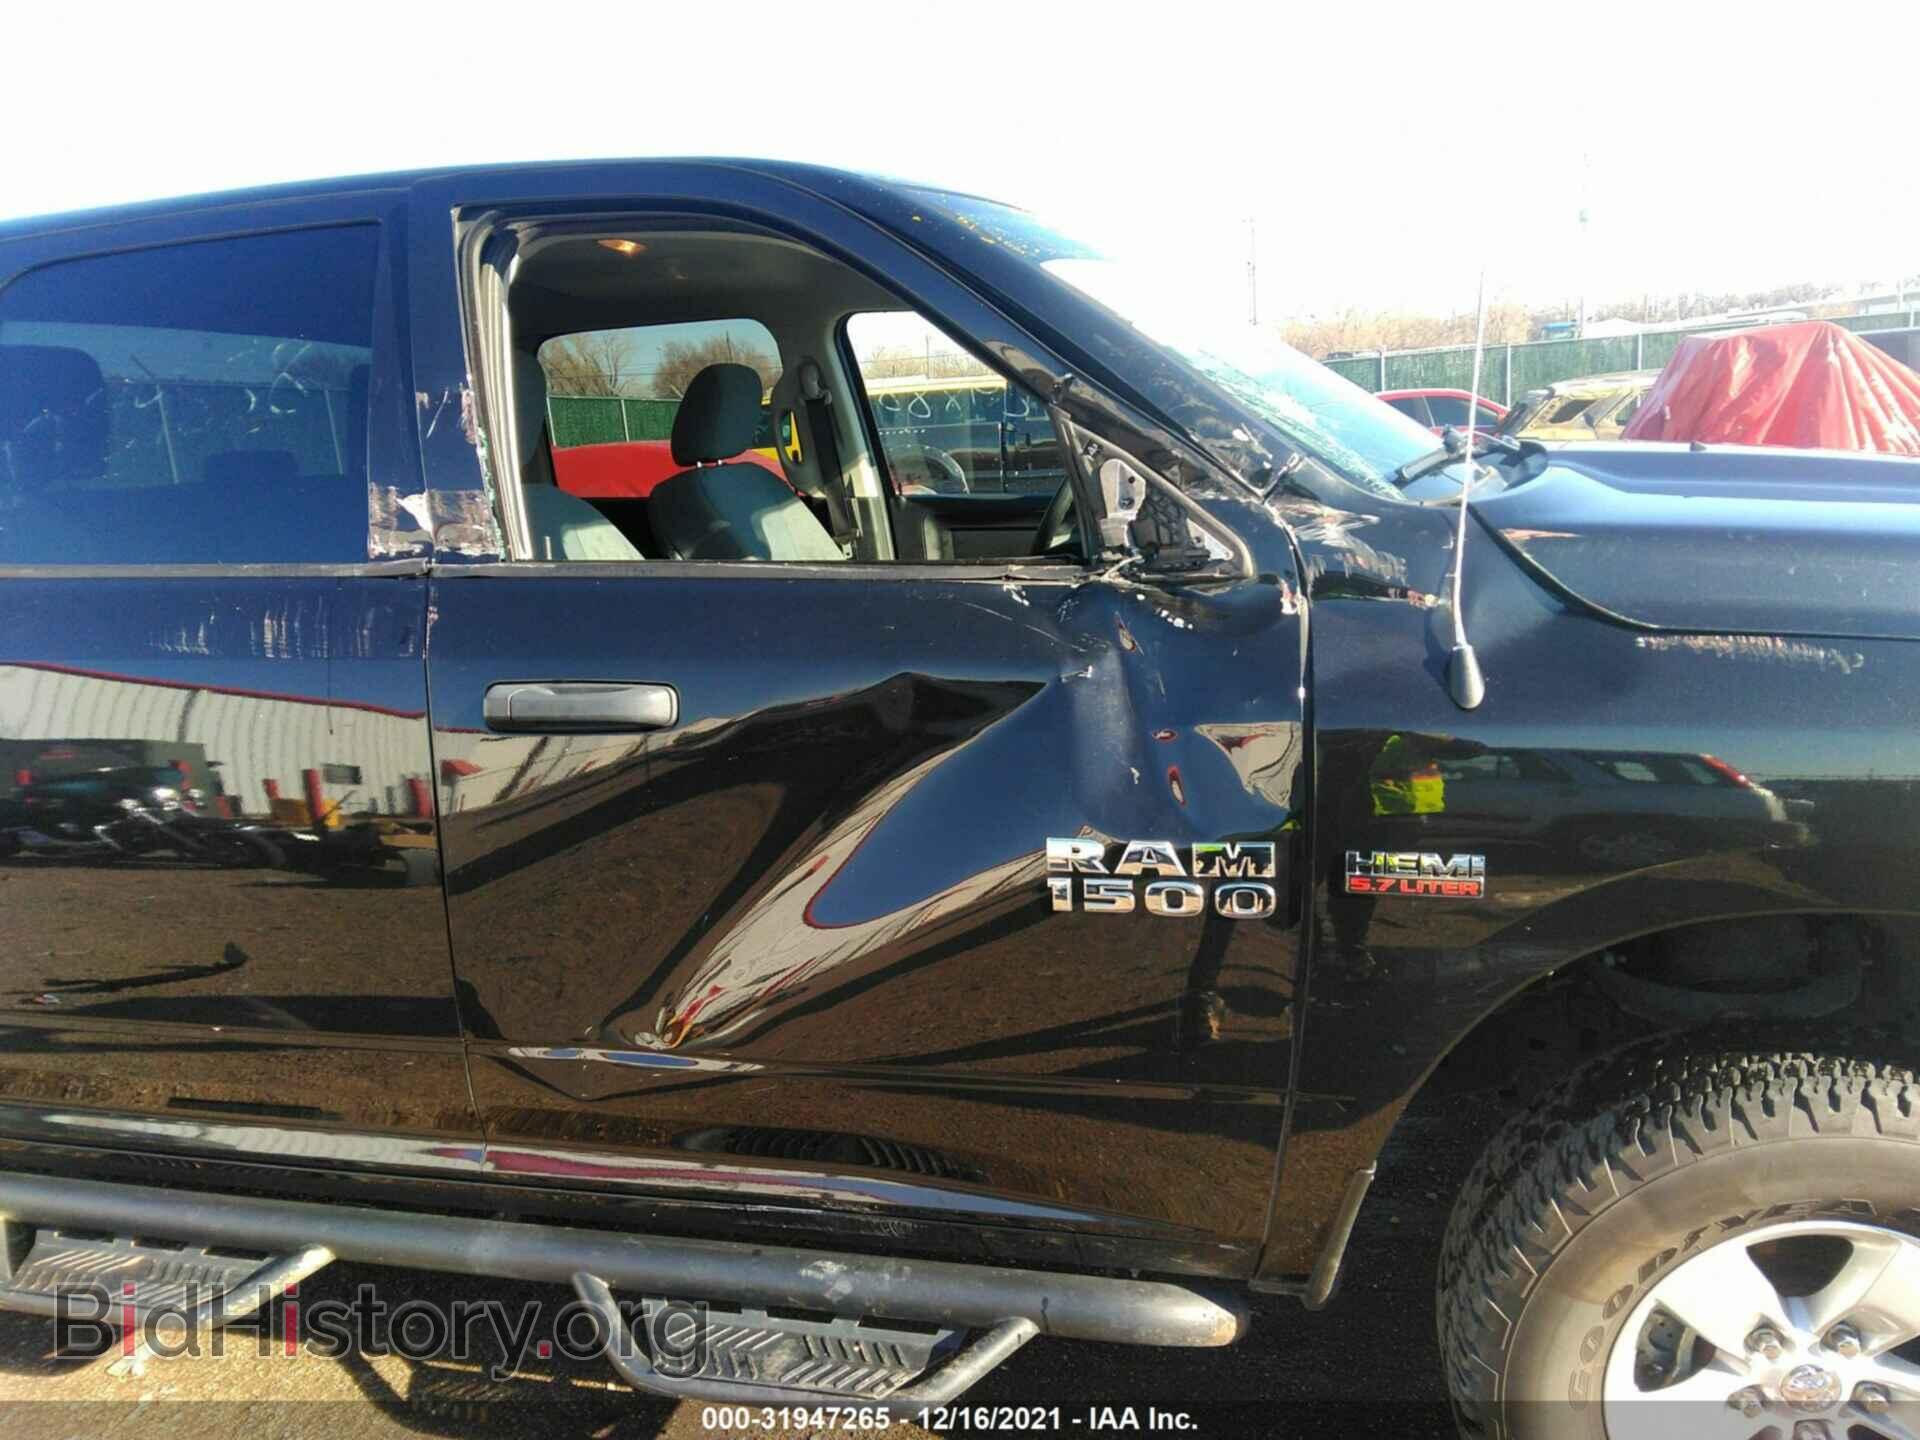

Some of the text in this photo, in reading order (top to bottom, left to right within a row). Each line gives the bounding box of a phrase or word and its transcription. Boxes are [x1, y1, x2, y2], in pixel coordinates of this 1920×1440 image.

[1046, 838, 1277, 878] RAM
[1345, 850, 1487, 878] HEMI
[1047, 876, 1278, 919] 1500
[1348, 877, 1483, 897] 5.7 LITER
